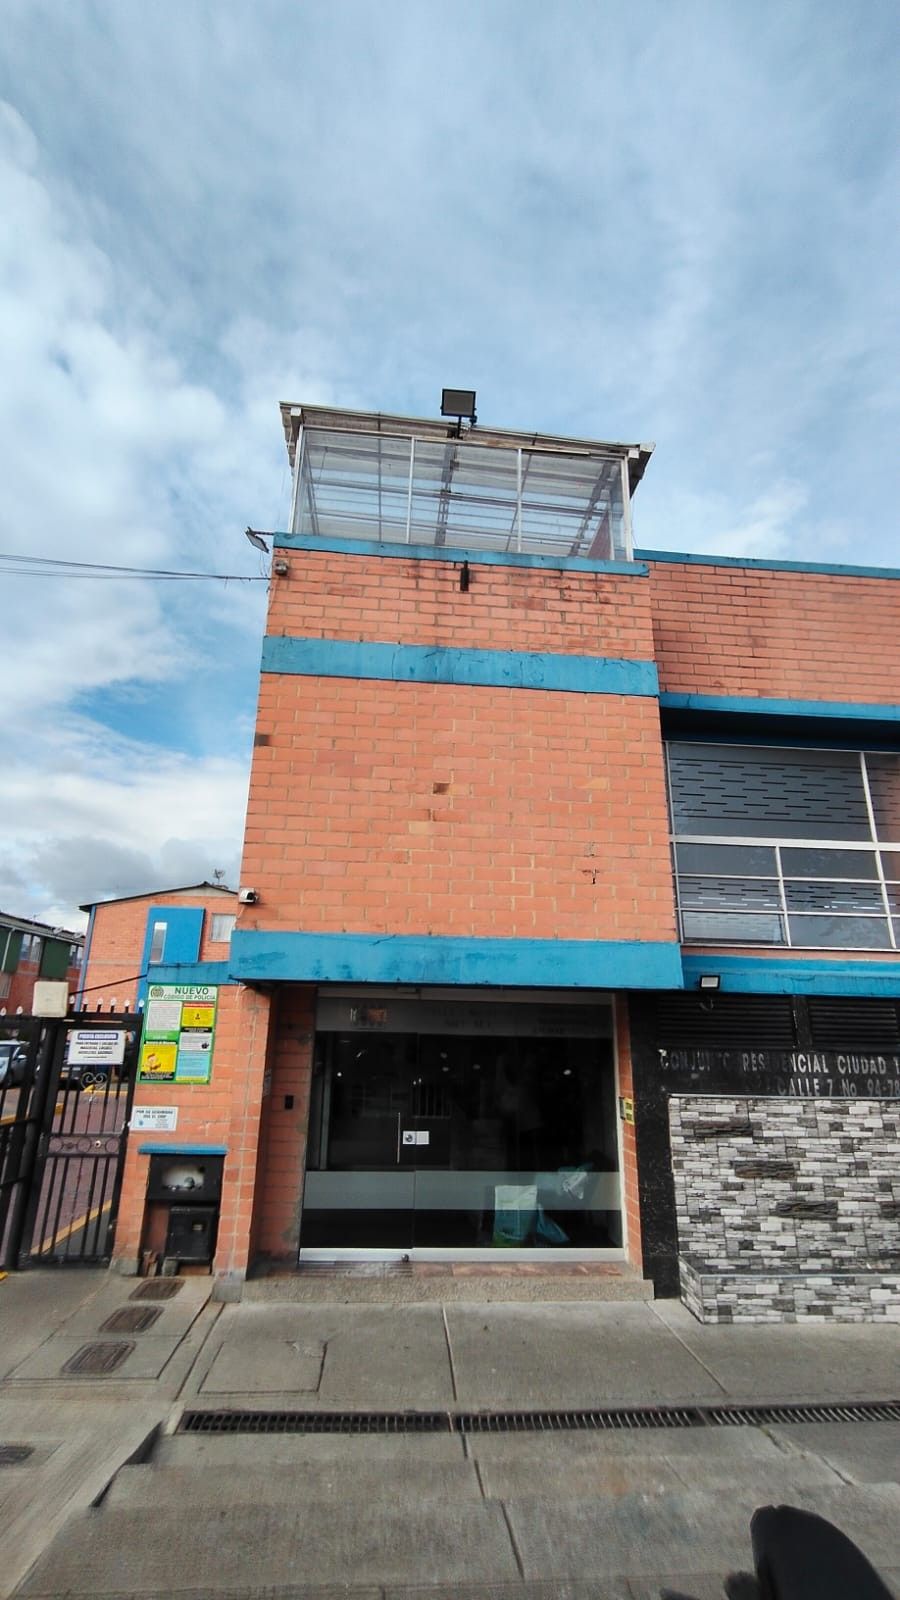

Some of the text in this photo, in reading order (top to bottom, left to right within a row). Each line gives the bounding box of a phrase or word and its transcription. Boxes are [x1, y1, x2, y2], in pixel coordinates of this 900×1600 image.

[174, 987, 209, 995] NUEVO
[837, 1055, 887, 1075] CIUDAD
[776, 1075, 821, 1097] CALLE
